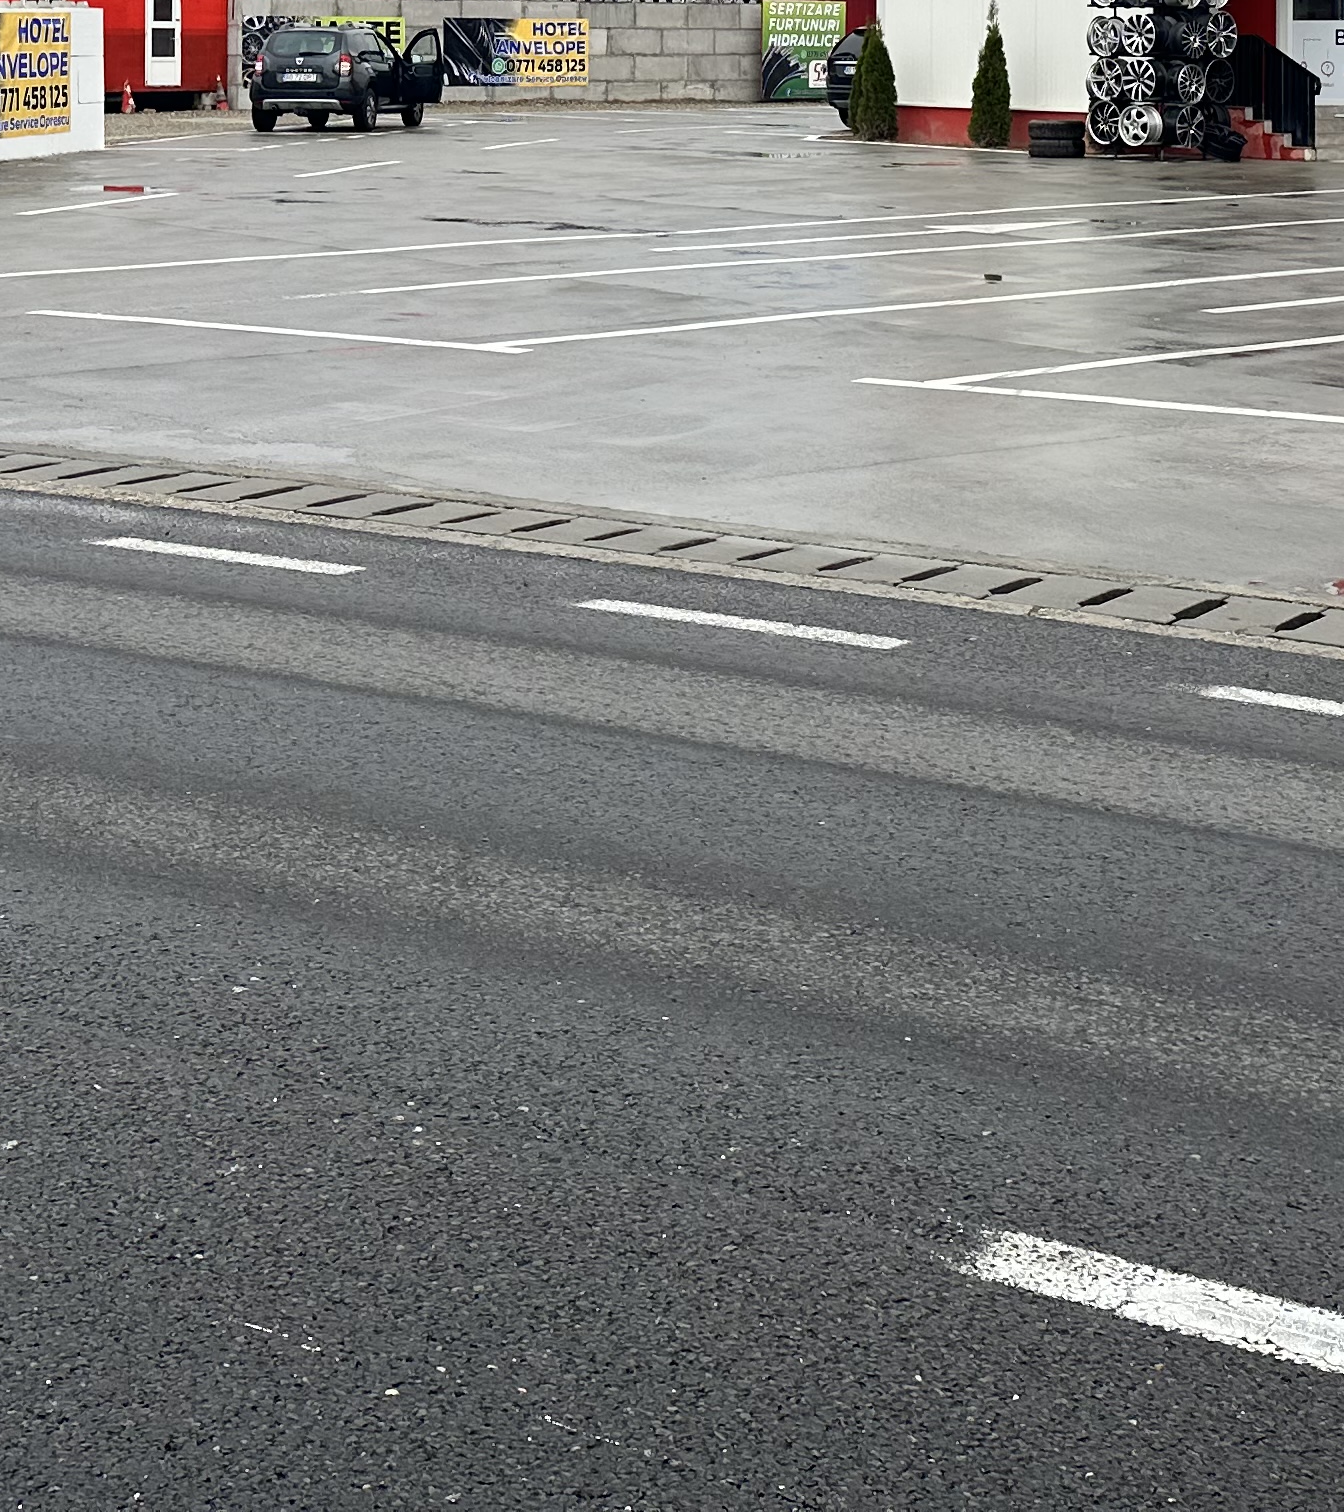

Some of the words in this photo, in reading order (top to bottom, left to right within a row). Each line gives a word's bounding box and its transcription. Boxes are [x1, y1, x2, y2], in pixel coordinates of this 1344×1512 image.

[768, 2, 841, 16] SERTIZARE
[18, 18, 68, 43] HOTEL
[532, 22, 586, 36] HOTEL
[768, 18, 840, 31] FURTUNURI
[768, 33, 840, 47] HIDRAULICE
[496, 40, 586, 55] ANVELOPE
[506, 59, 534, 73] 0771
[538, 59, 563, 73] 458
[565, 59, 586, 72] 125
[23, 85, 47, 110] 458
[49, 84, 68, 109] 125
[9, 117, 38, 131] Service
